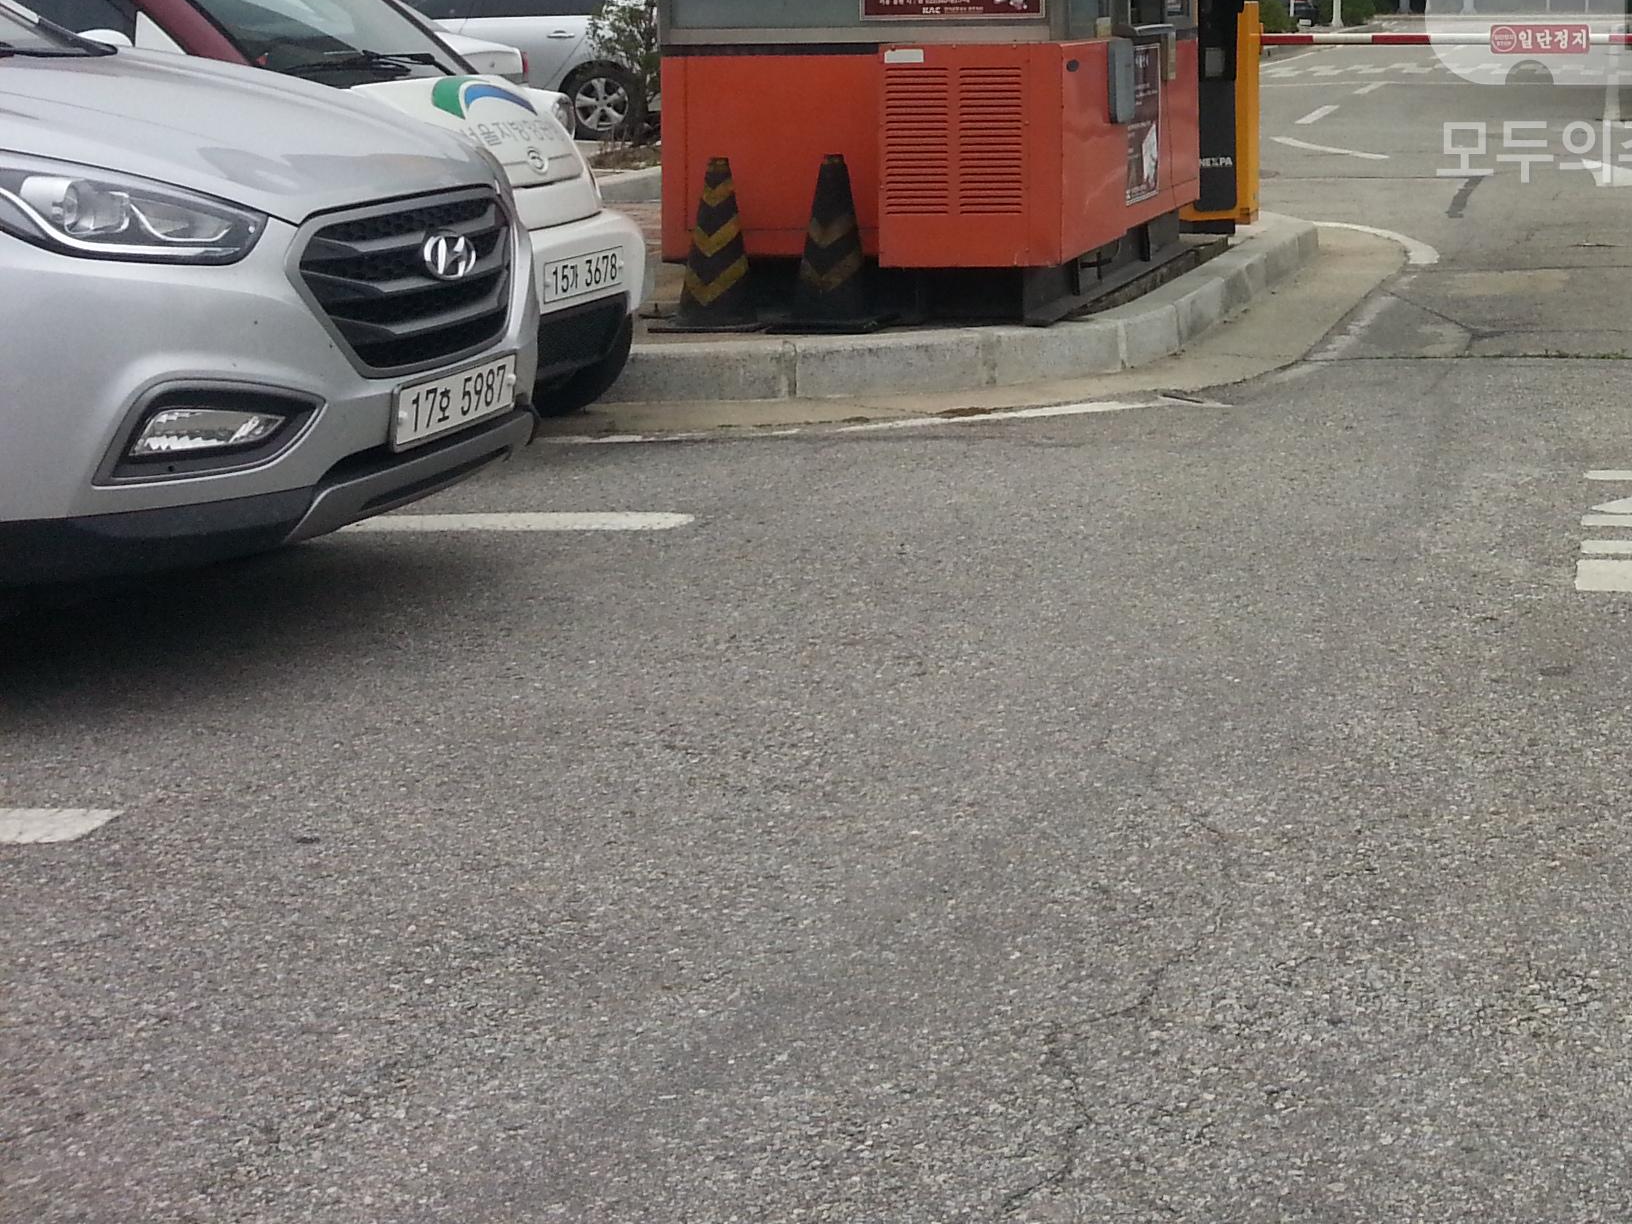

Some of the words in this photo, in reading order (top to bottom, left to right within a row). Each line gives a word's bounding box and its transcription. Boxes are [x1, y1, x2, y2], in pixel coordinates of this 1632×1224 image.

[1519, 29, 1587, 49] 일단정지
[552, 264, 578, 295] 15가
[585, 253, 618, 288] 3678
[411, 387, 450, 433] 17호
[460, 364, 508, 417] 5987
